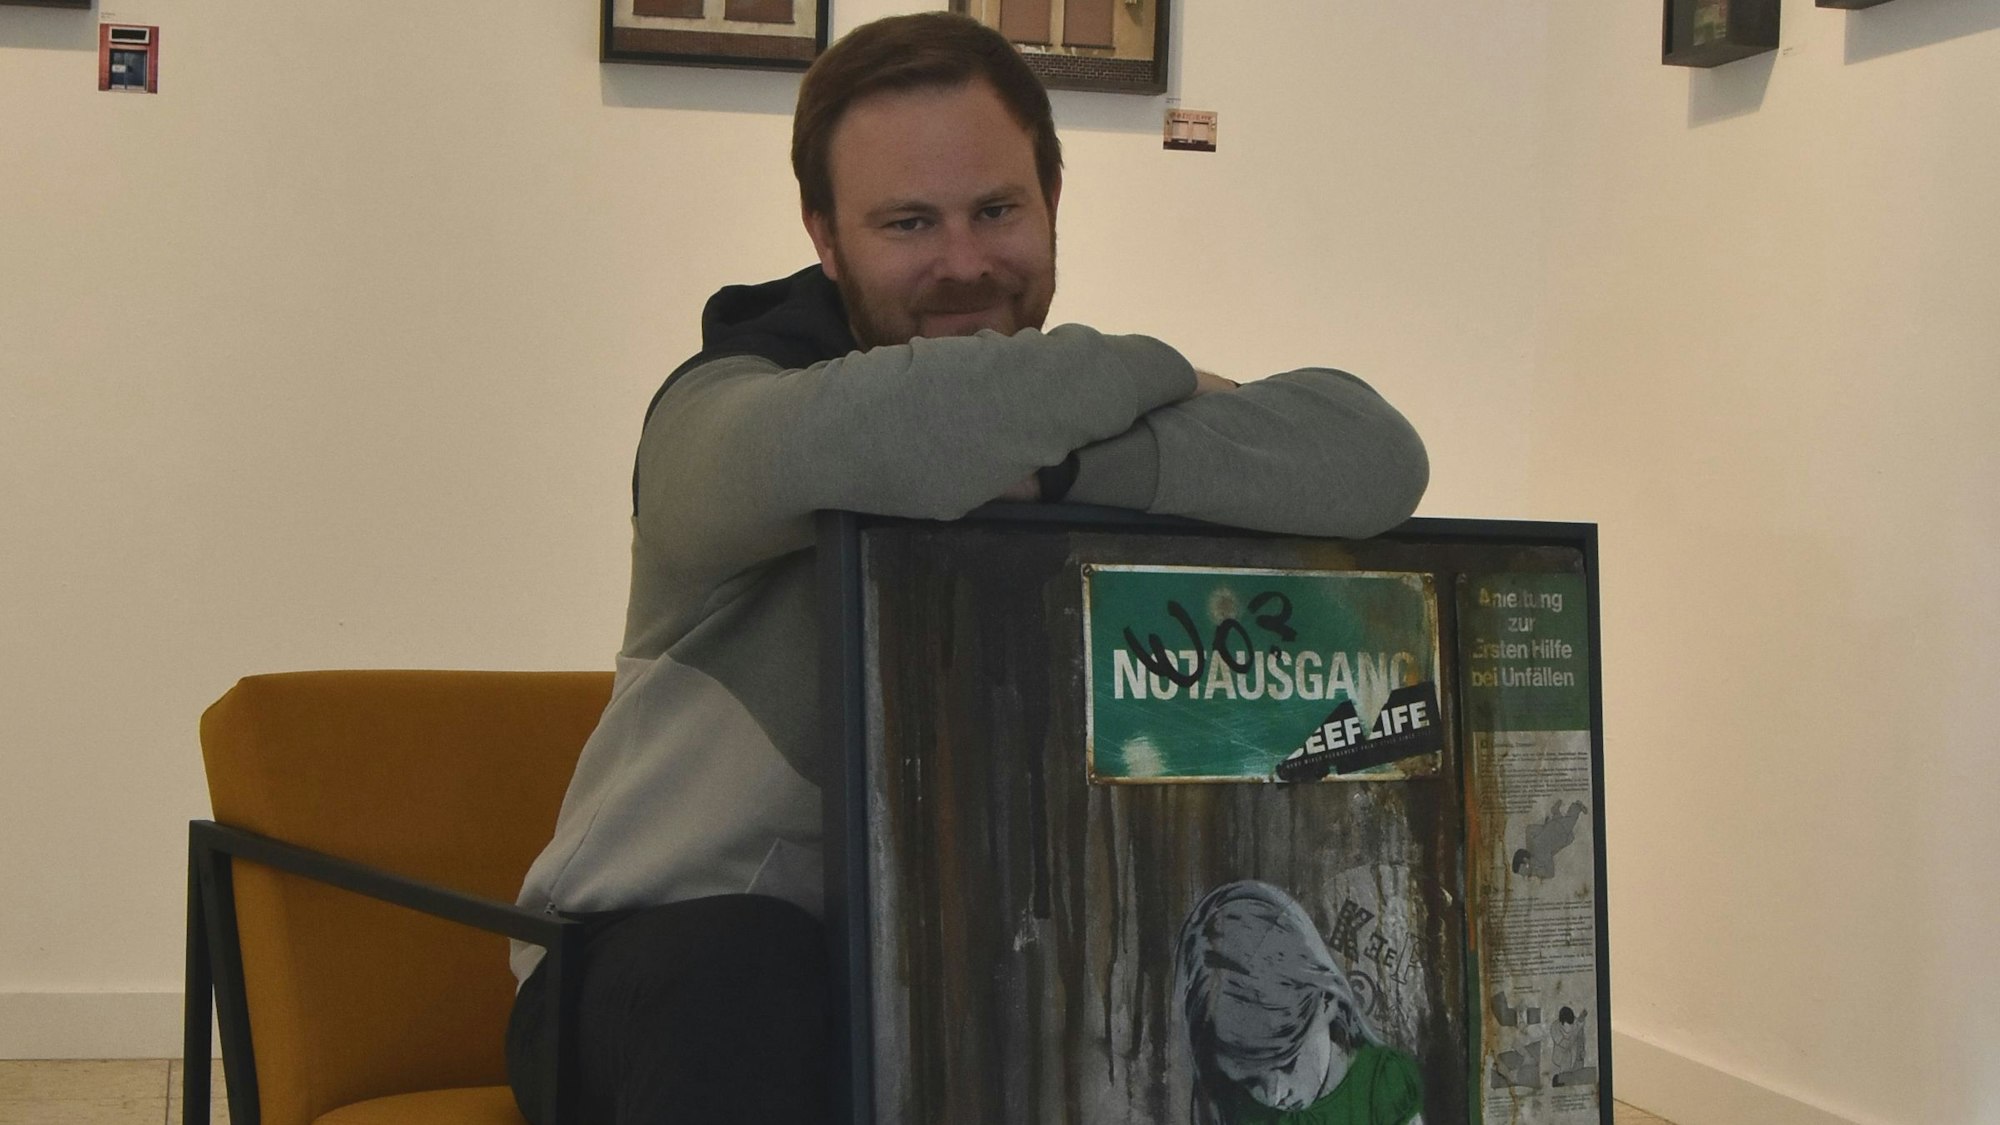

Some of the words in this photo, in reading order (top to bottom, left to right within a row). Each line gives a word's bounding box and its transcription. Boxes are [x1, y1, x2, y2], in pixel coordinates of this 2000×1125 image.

[1479, 588, 1563, 613] Anletung
[1508, 617, 1536, 632] zur
[1532, 638, 1573, 659] Hilfe
[1472, 667, 1498, 687] bei
[1501, 667, 1575, 687] Unfällen
